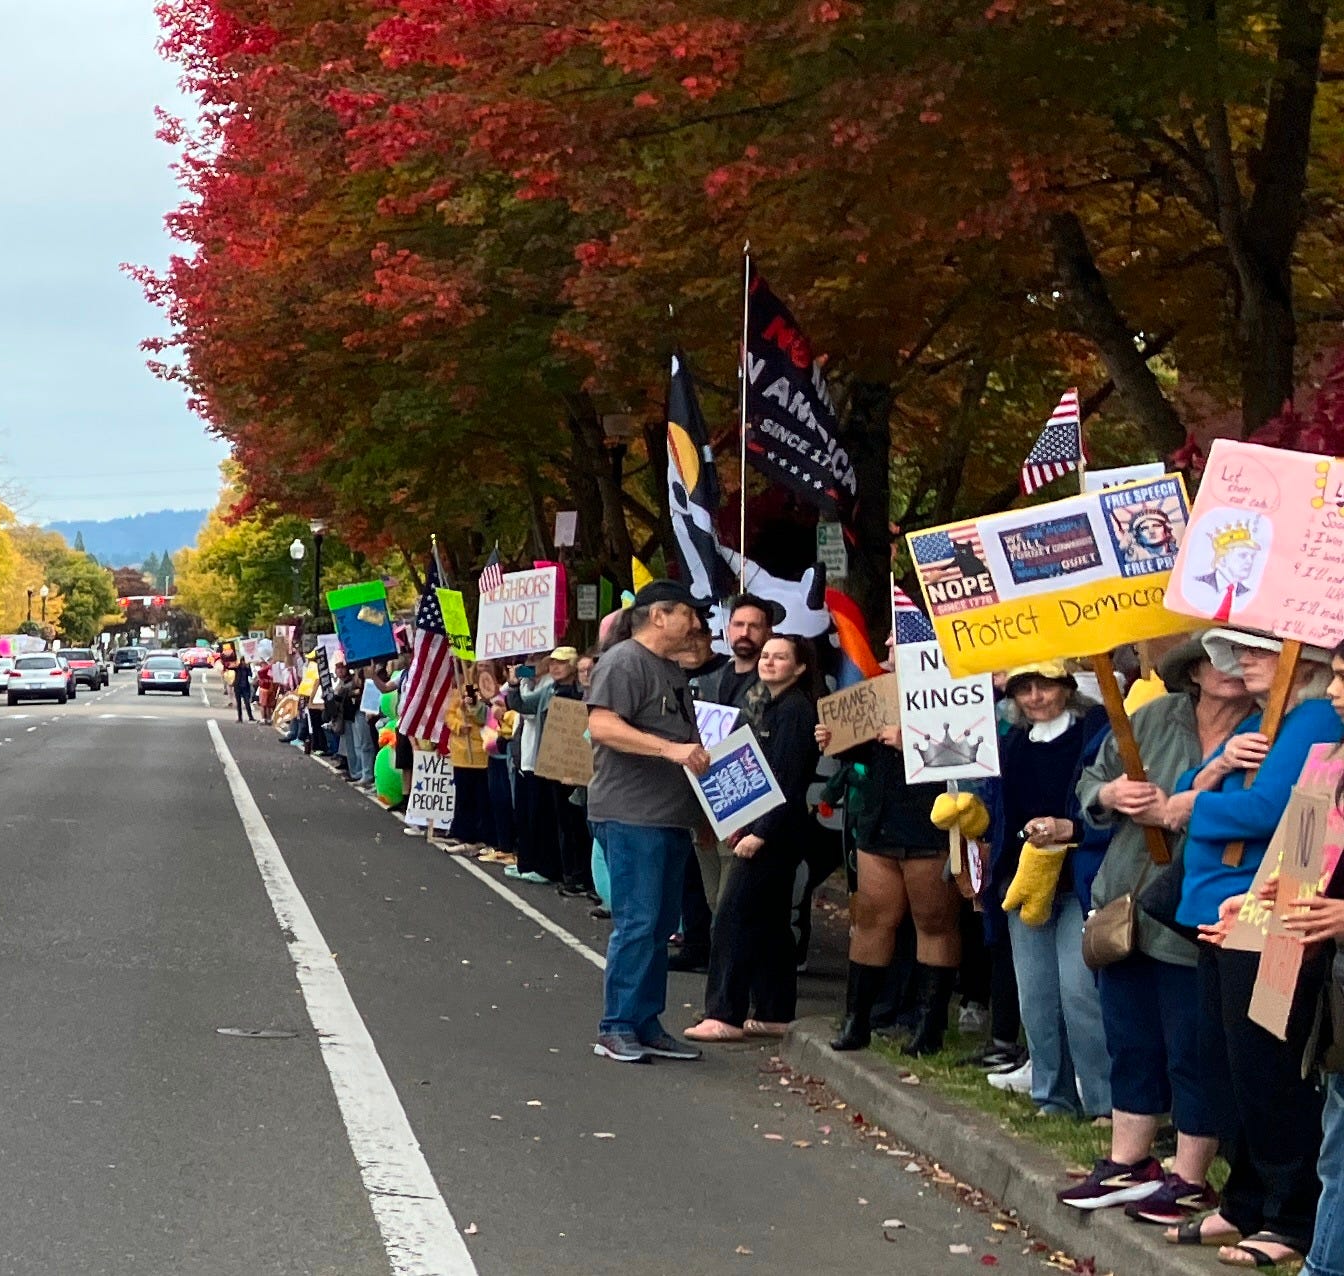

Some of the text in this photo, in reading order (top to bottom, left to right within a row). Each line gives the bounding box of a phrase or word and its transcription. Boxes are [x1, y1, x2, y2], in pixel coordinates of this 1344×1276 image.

[761, 418, 811, 454] SINCE
[1221, 464, 1244, 483] Let
[1105, 491, 1134, 508] FREE
[1135, 481, 1177, 501] SPEECH
[1124, 559, 1155, 577] FREE
[927, 573, 994, 603] NOPE
[503, 601, 540, 625] NOT
[484, 626, 548, 655] ENEMIES
[952, 605, 1039, 652] Protect
[920, 649, 949, 671] N
[822, 683, 876, 724] FEMMES
[906, 684, 985, 711] KINGS
[423, 754, 452, 775] WE
[424, 777, 448, 794] THE
[700, 774, 724, 813] 1776
[715, 766, 741, 807] SINCE
[412, 794, 454, 812] PEOPLE
